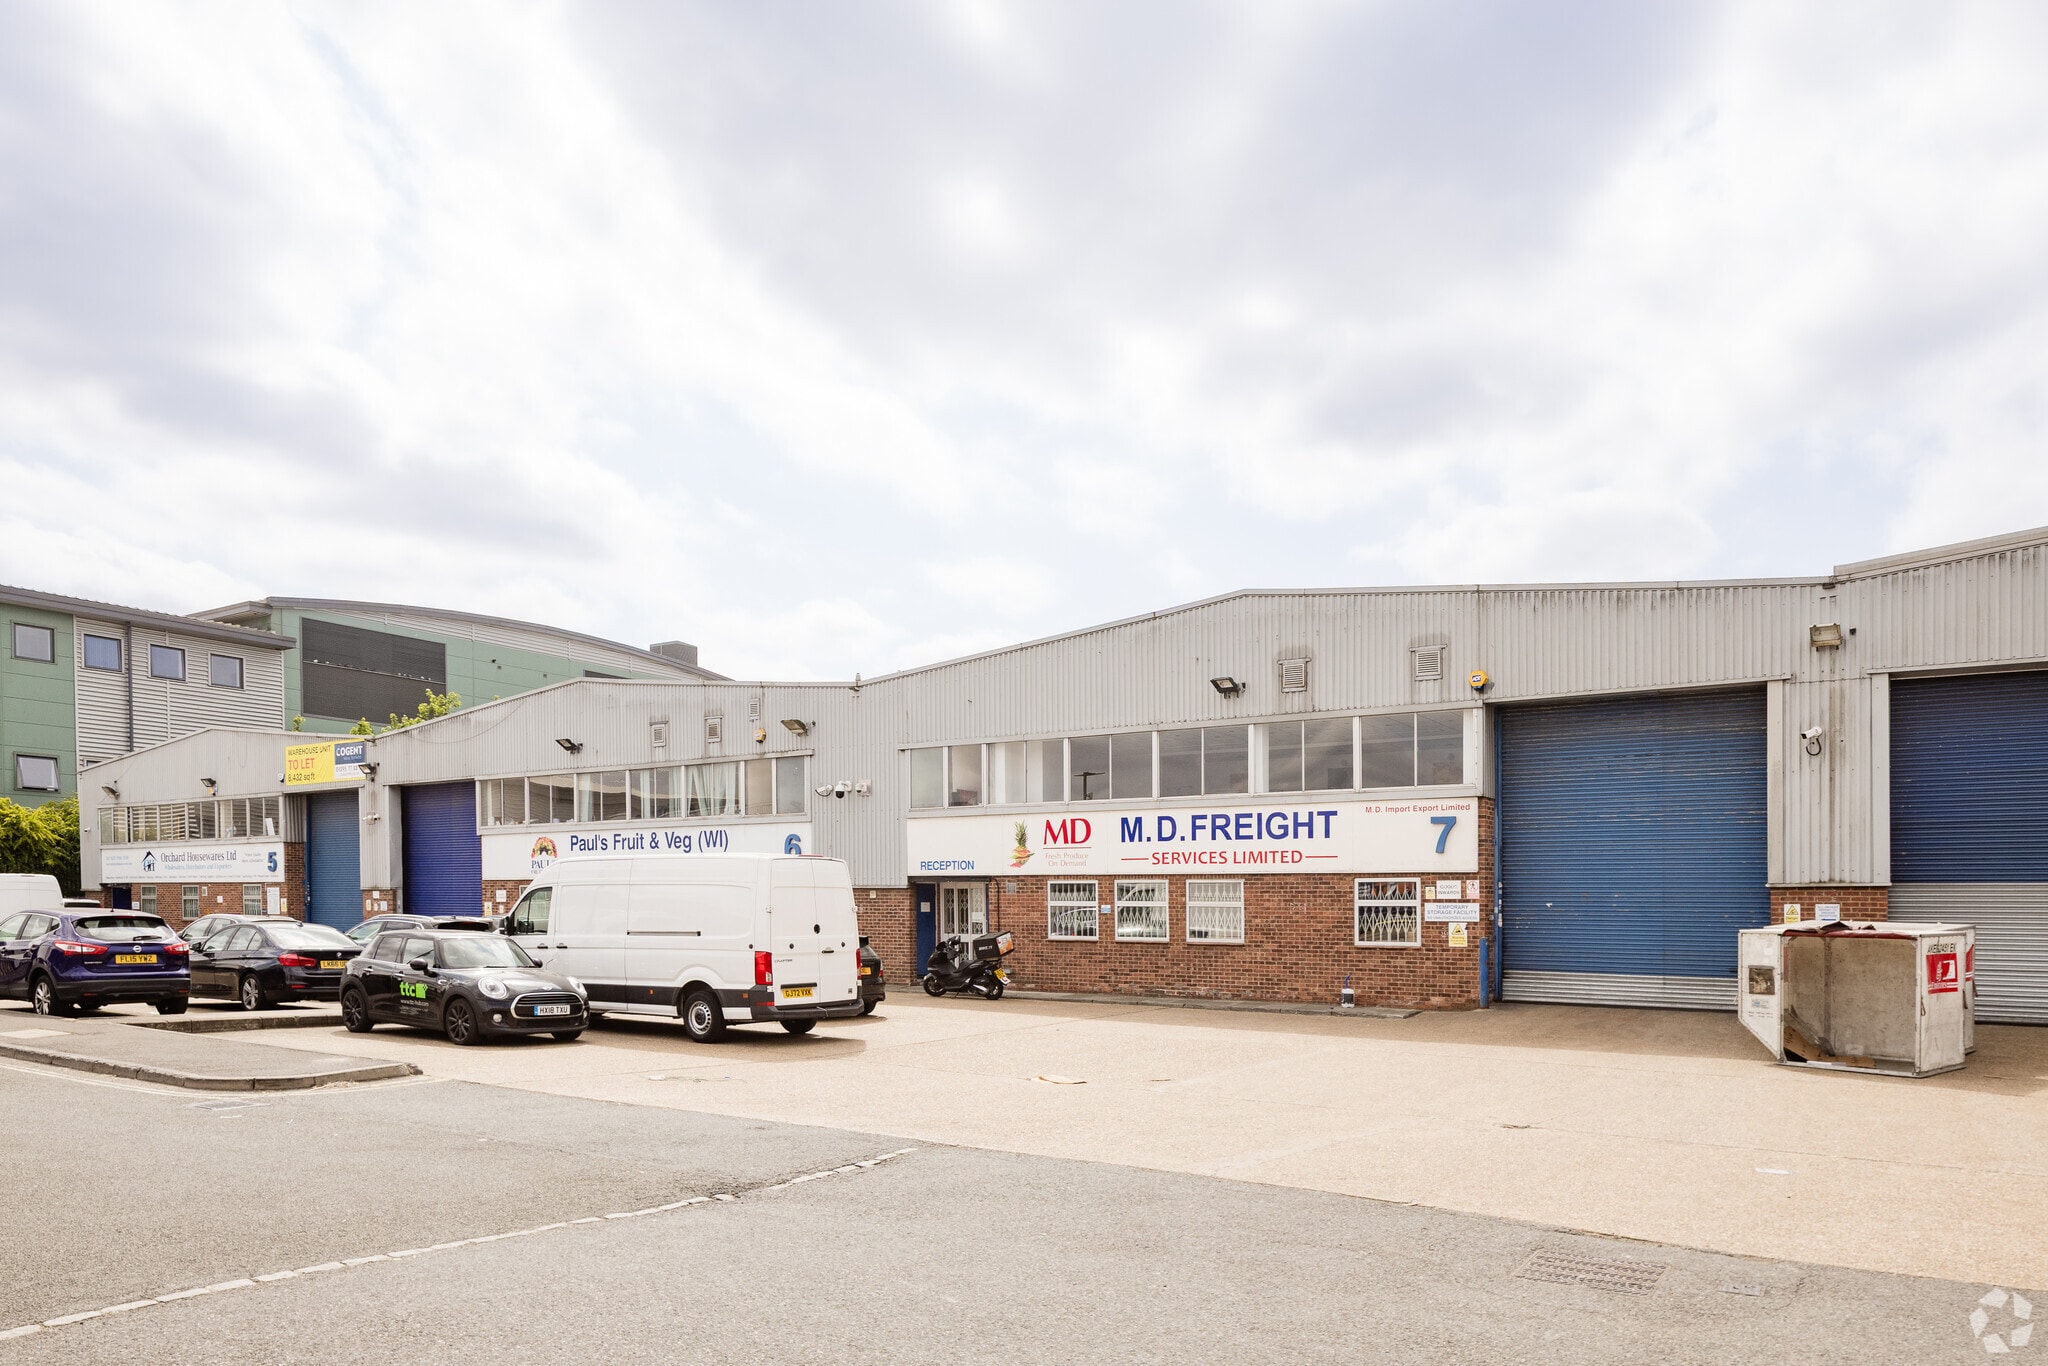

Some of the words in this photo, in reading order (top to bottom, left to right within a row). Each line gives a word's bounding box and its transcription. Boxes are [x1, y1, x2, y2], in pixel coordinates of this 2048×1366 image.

[288, 746, 318, 756] WAREHOUSE
[336, 746, 363, 756] COGENT
[288, 759, 299, 770] TO
[300, 758, 315, 769] LET
[1385, 806, 1410, 814] Import
[1412, 804, 1439, 813] Export
[1441, 803, 1470, 811] Limited
[1043, 818, 1092, 845] MD
[1430, 816, 1456, 854] 7
[570, 834, 608, 851] Paul's
[613, 833, 644, 850] Fruit
[649, 832, 659, 849] &
[665, 831, 692, 853] Veg
[698, 830, 729, 852] (WI)
[784, 834, 801, 855] 6
[161, 853, 186, 862] Orchard
[187, 851, 225, 862] Housewares
[226, 850, 237, 861] Ltd
[267, 851, 278, 872] 5
[1151, 851, 1228, 865] SERVICES
[1233, 850, 1303, 864] LIMITED
[920, 860, 975, 871] RECEPTION
[400, 982, 415, 997] ttc
[785, 989, 800, 998] GJ72
[801, 988, 812, 997] VXK
[540, 1006, 555, 1014] HX18
